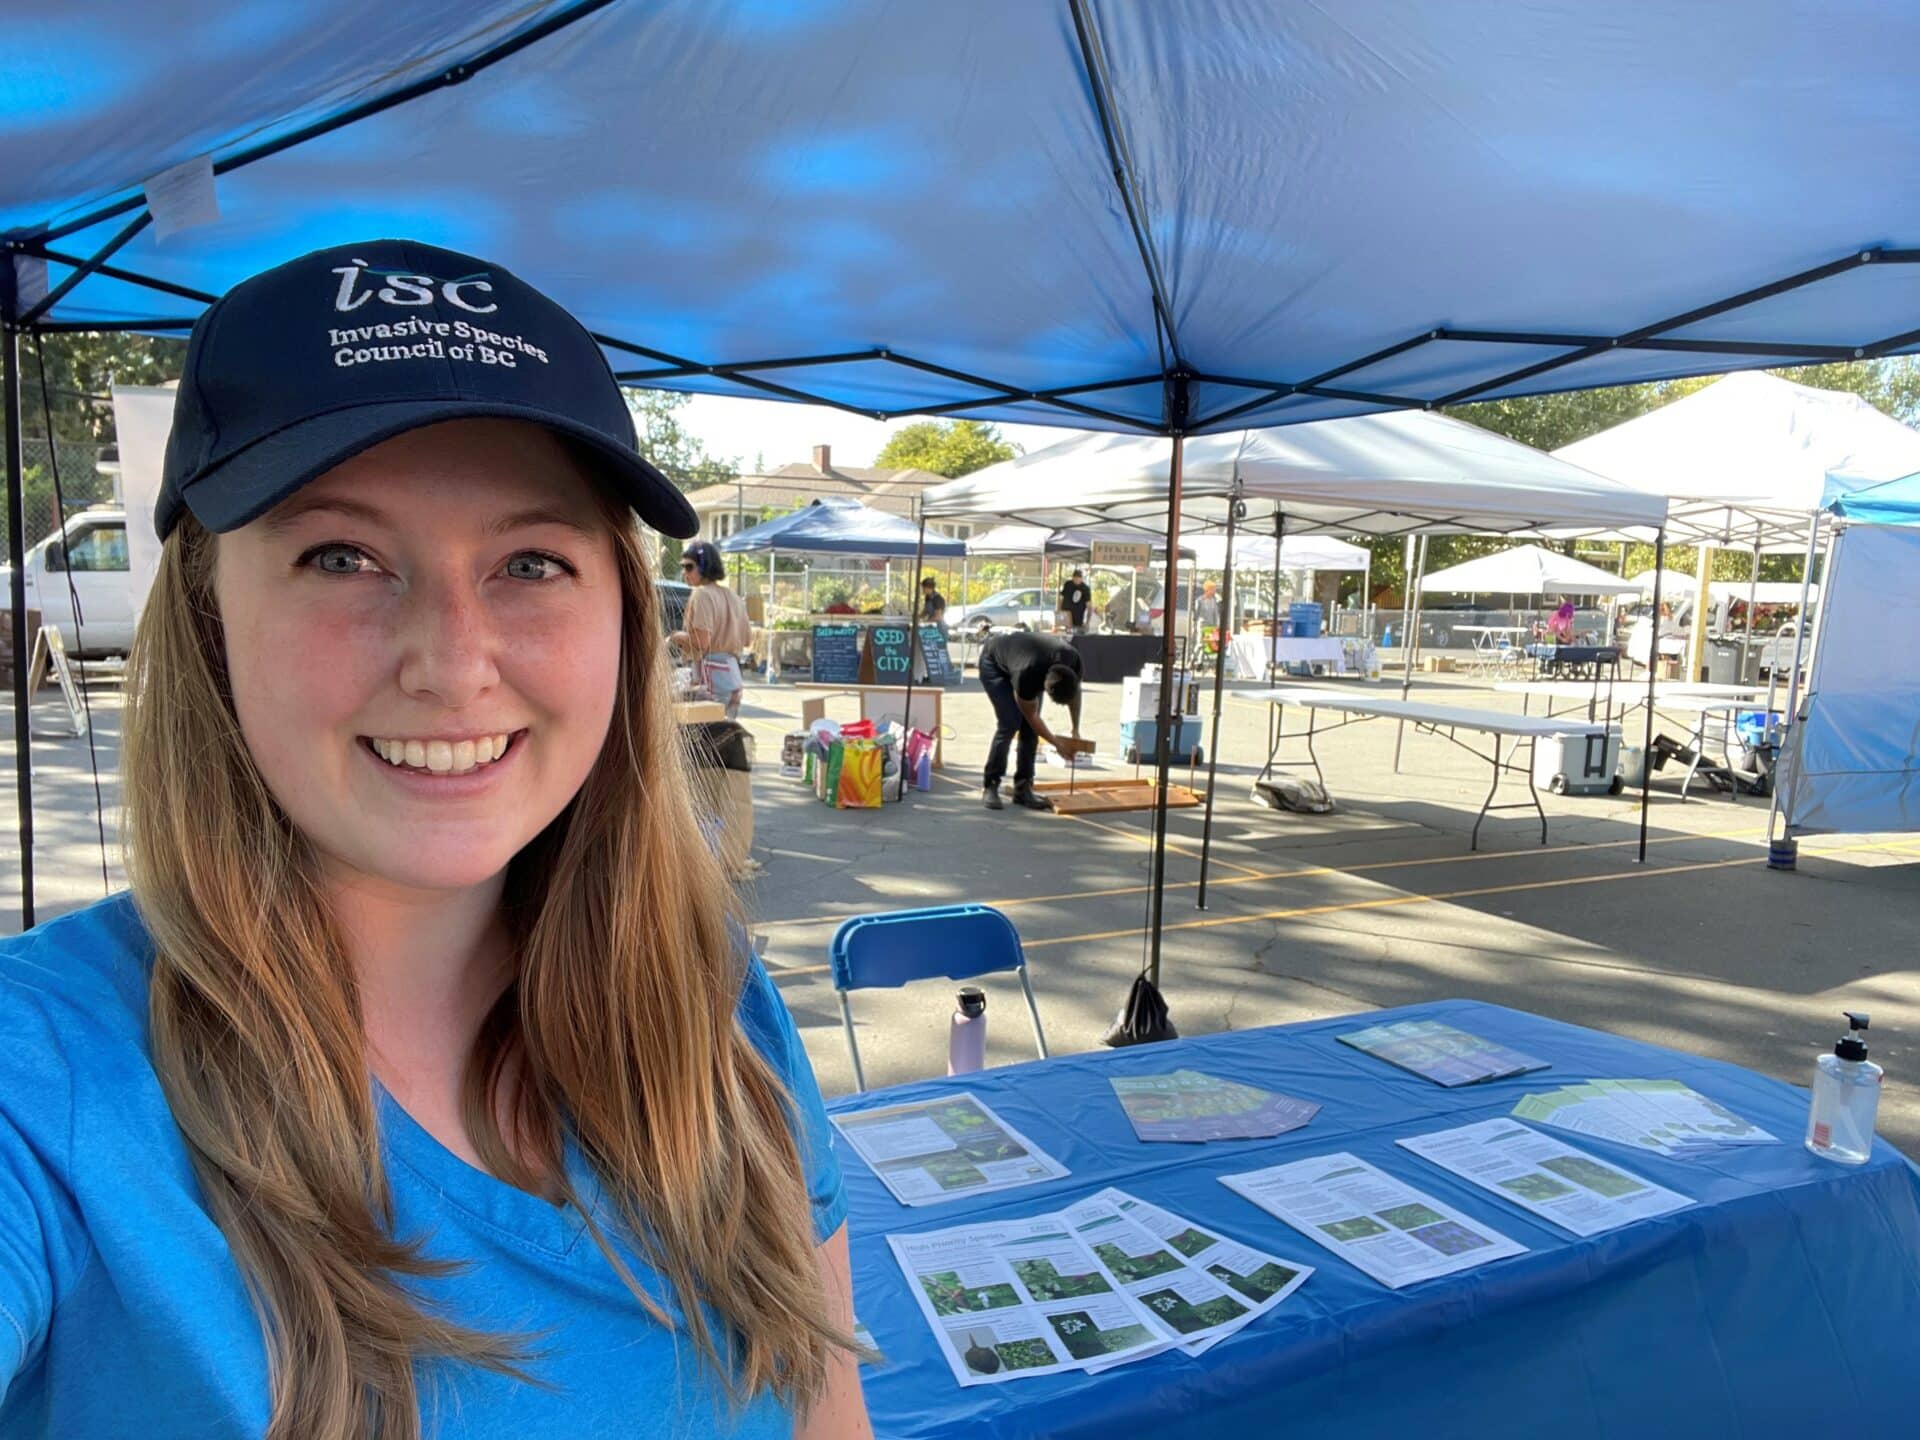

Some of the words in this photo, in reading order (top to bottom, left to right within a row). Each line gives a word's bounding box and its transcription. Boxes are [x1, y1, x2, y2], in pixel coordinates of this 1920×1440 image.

[328, 315, 451, 347] Invasive
[452, 320, 549, 364] Species
[334, 338, 446, 367] Council
[448, 343, 475, 362] of
[478, 345, 517, 368] BC
[875, 628, 905, 644] SEED
[877, 655, 910, 672] CITY
